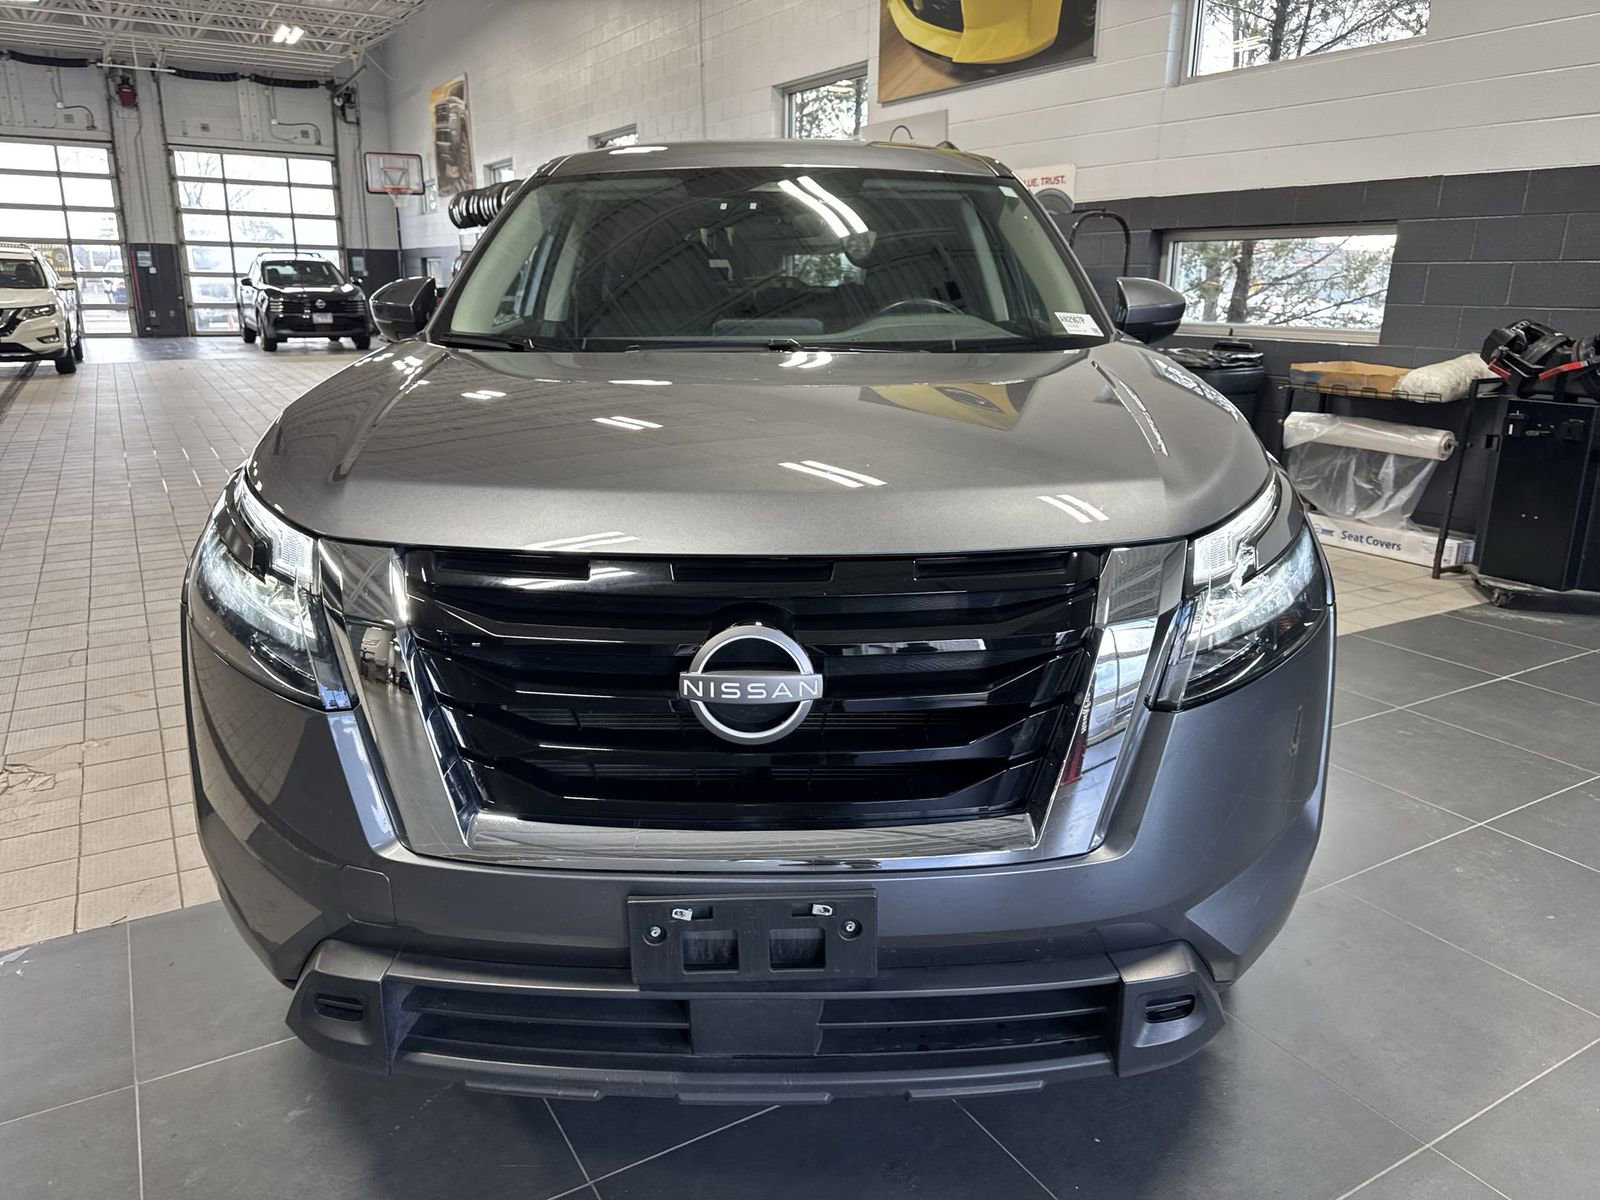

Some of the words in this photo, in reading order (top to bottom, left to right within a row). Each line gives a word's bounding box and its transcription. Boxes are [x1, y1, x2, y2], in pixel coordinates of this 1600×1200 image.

[1040, 175, 1066, 186] TRUST.
[1340, 530, 1364, 543] Seat
[1365, 535, 1402, 551] Covers
[683, 679, 818, 699] NISSAN
